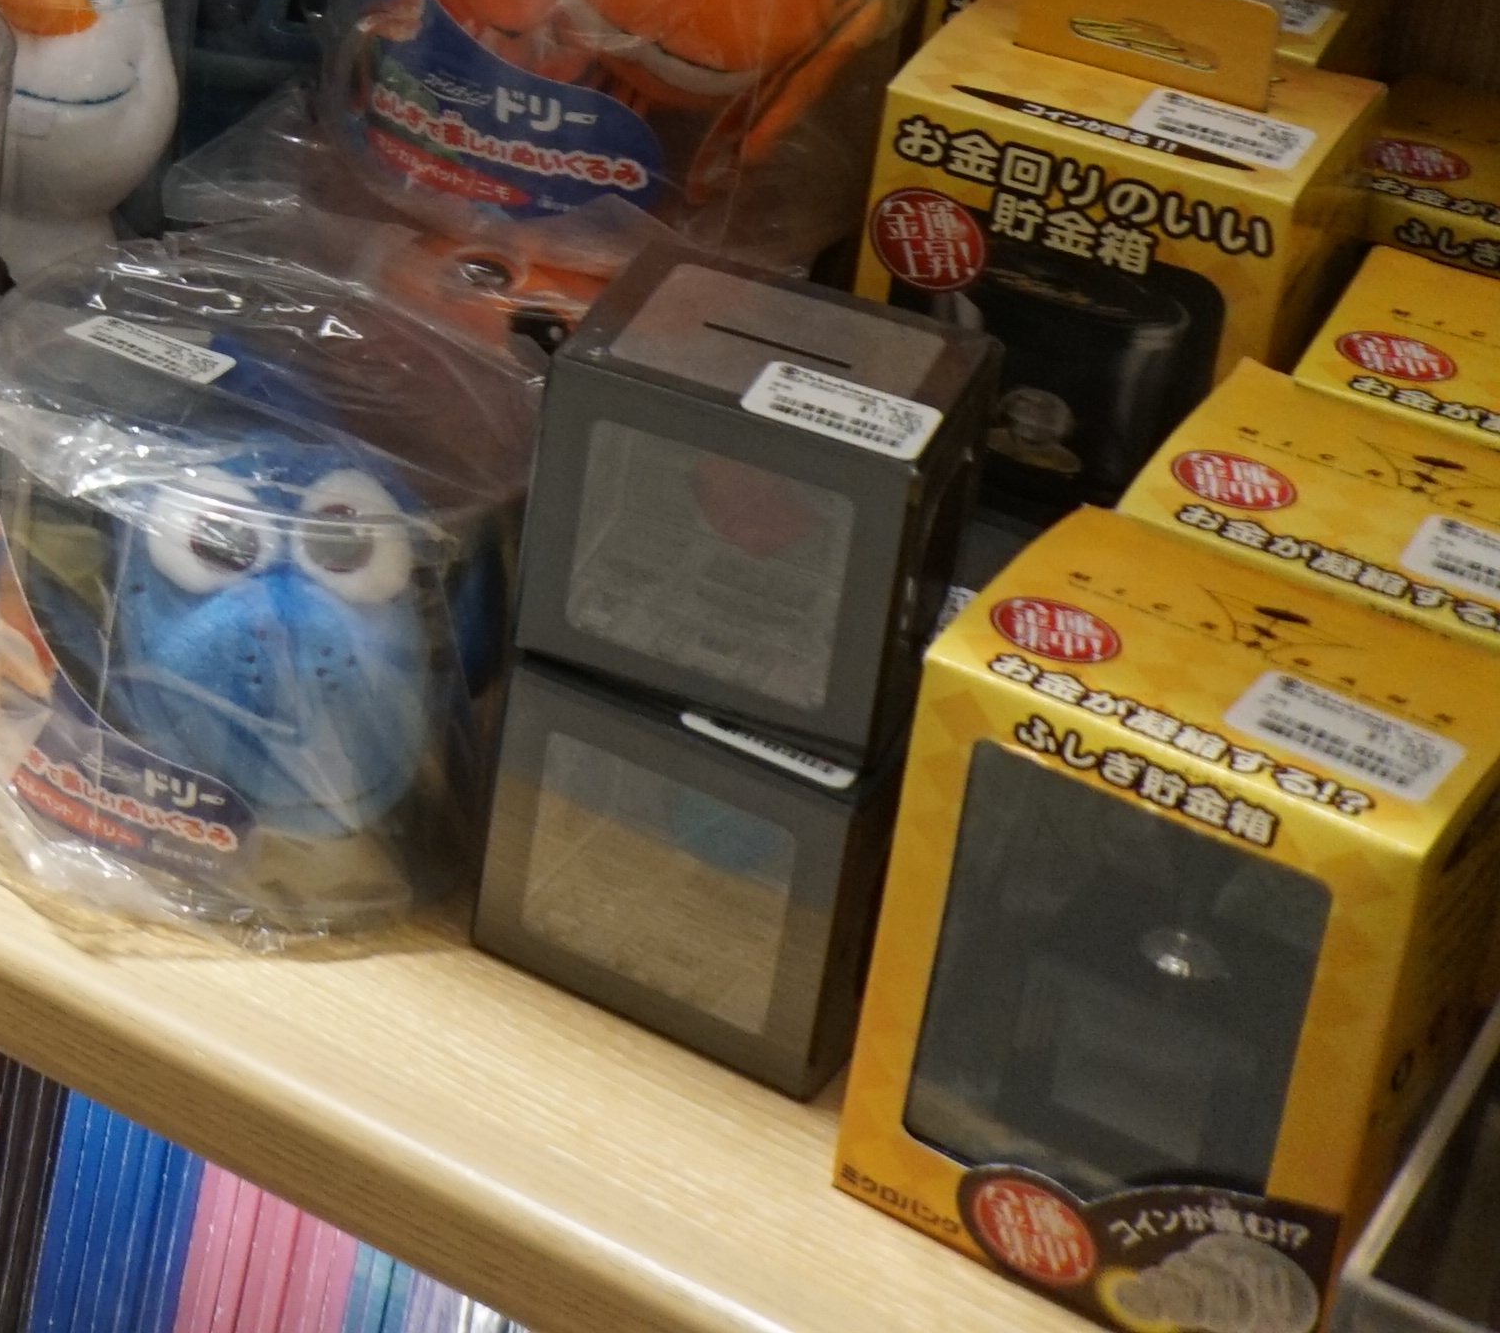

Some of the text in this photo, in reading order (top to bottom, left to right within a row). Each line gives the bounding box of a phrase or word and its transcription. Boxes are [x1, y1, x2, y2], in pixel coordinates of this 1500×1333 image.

[495, 85, 599, 132] ドリー
[896, 116, 1274, 259] お金回りのいい
[991, 194, 1155, 277] 貯金箱
[144, 768, 226, 807] ドリー
[1014, 713, 1282, 850] ふしぎ貯金箱
